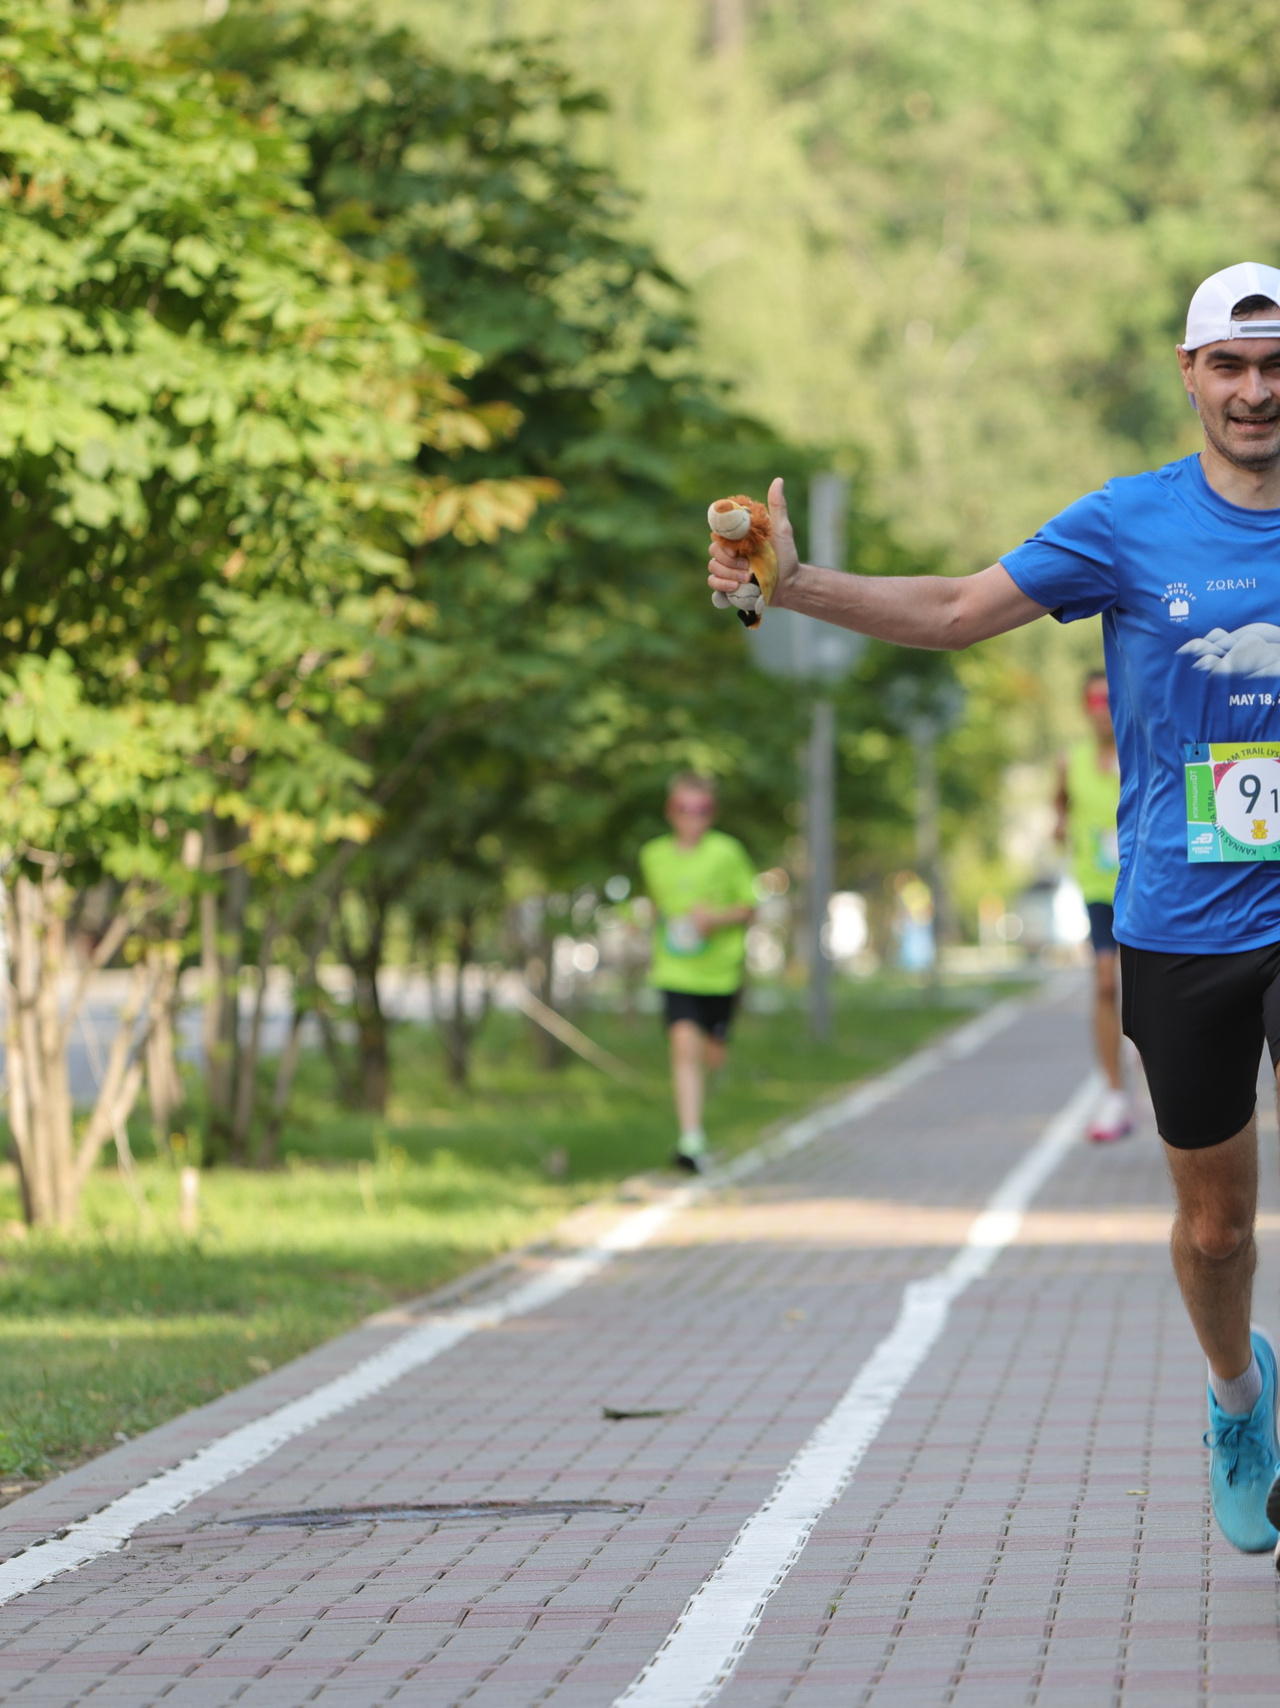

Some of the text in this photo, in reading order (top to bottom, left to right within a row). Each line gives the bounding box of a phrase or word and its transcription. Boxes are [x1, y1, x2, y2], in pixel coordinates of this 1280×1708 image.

[1166, 582, 1188, 591] WINE
[1206, 578, 1256, 591] ZORAH
[1161, 588, 1197, 604] REPUBLIC
[1229, 694, 1256, 706] MAY
[1258, 693, 1276, 707] 18,
[1215, 752, 1240, 777] DREAM
[1241, 747, 1265, 757] TRAIL
[1207, 789, 1257, 856] KANNAS ULTRA TRAIL
